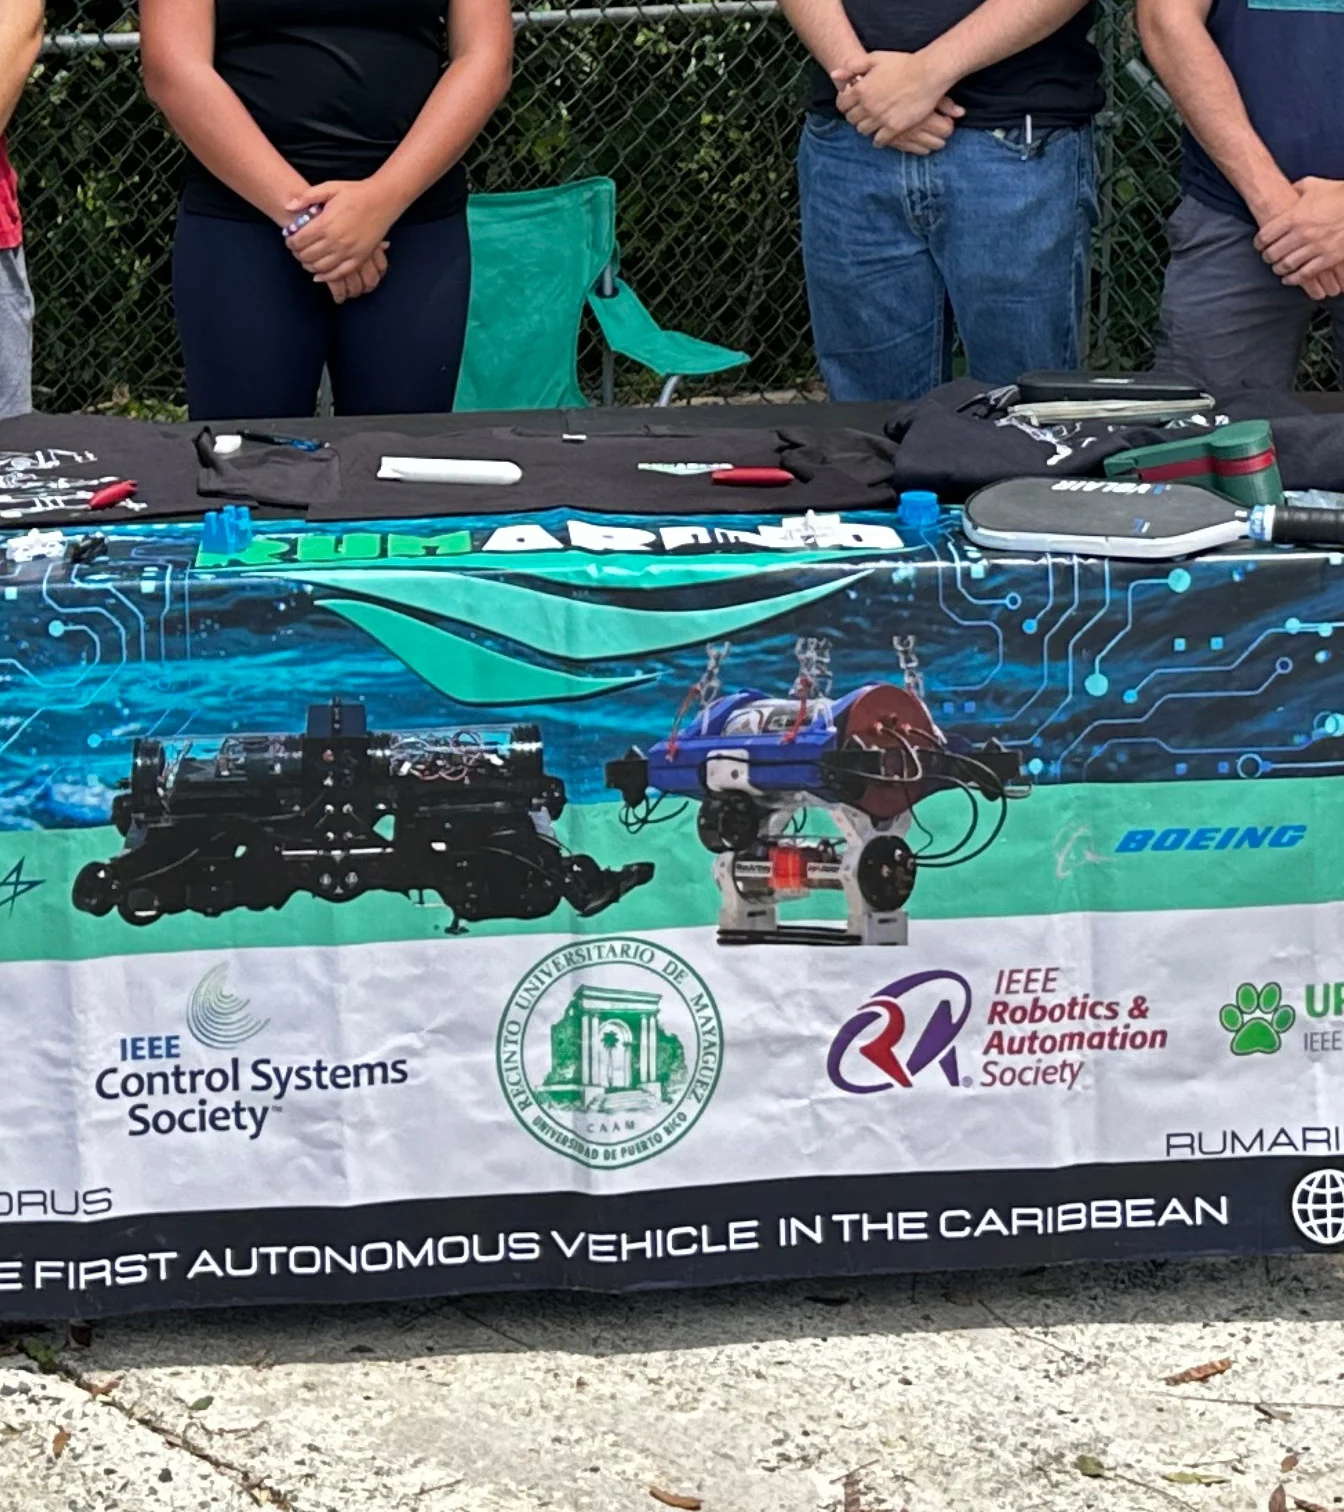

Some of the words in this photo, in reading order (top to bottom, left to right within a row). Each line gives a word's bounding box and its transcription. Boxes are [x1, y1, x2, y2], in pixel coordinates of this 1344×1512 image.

[1114, 824, 1307, 854] BOEING
[514, 943, 656, 1011] UNIVERSITARIO
[661, 960, 690, 986] DE
[994, 967, 1060, 995] IEEE
[987, 996, 1120, 1025] Robotics
[1127, 995, 1150, 1020] &
[120, 1035, 181, 1061] IEEE
[690, 992, 718, 1105] MAYAGUEZ
[981, 1026, 1168, 1056] Automation
[1303, 1031, 1343, 1052] IEEE
[95, 1057, 239, 1100] Control
[250, 1058, 409, 1100] Systems
[503, 1019, 533, 1112] RECINTO
[980, 1059, 1085, 1092] Society
[128, 1099, 269, 1140] Society
[532, 1115, 600, 1161] UNIVERSIDAD
[603, 1147, 618, 1161] DE
[620, 1134, 663, 1160] PUERTO
[665, 1111, 688, 1136] RICO
[34, 1251, 177, 1289] FIRST
[187, 1230, 541, 1279] AUTONOMOUS
[550, 1220, 759, 1263] VEHICLE
[778, 1216, 823, 1248] IN
[831, 1209, 929, 1244] THE
[937, 1195, 1229, 1240] CARIBBEAN
